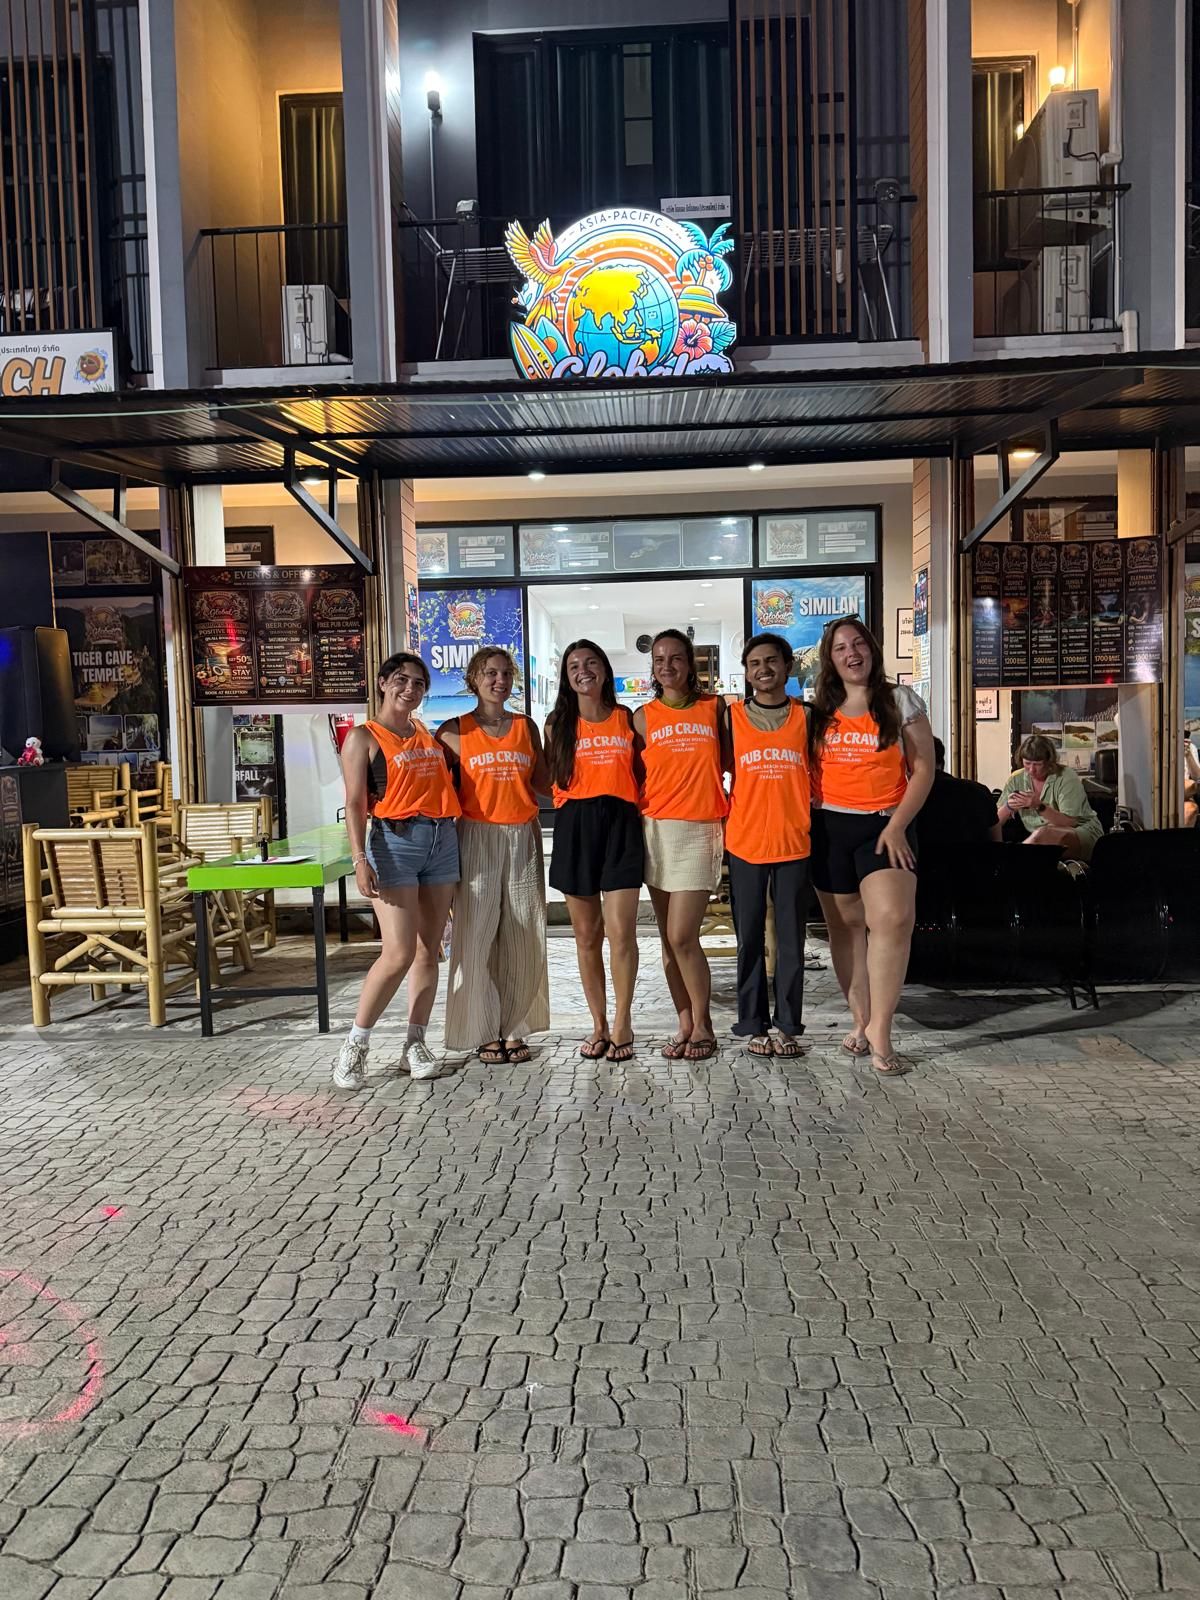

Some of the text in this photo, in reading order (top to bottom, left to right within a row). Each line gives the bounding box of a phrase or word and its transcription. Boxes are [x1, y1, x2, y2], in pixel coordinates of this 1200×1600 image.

[0, 345, 40, 355] ประเทศไทย)
[234, 570, 316, 580] EVENTS & OFFES
[799, 596, 860, 617] SIMILAN
[283, 621, 302, 629] PONG
[72, 649, 133, 667] TIGER CAVE
[430, 643, 508, 670] SIMI
[81, 667, 125, 683] TEMPLE
[651, 725, 674, 744] PUB
[843, 731, 880, 748] CRAW
[574, 737, 592, 751] UB
[469, 752, 495, 770] PUB
[740, 749, 762, 769] PUB
